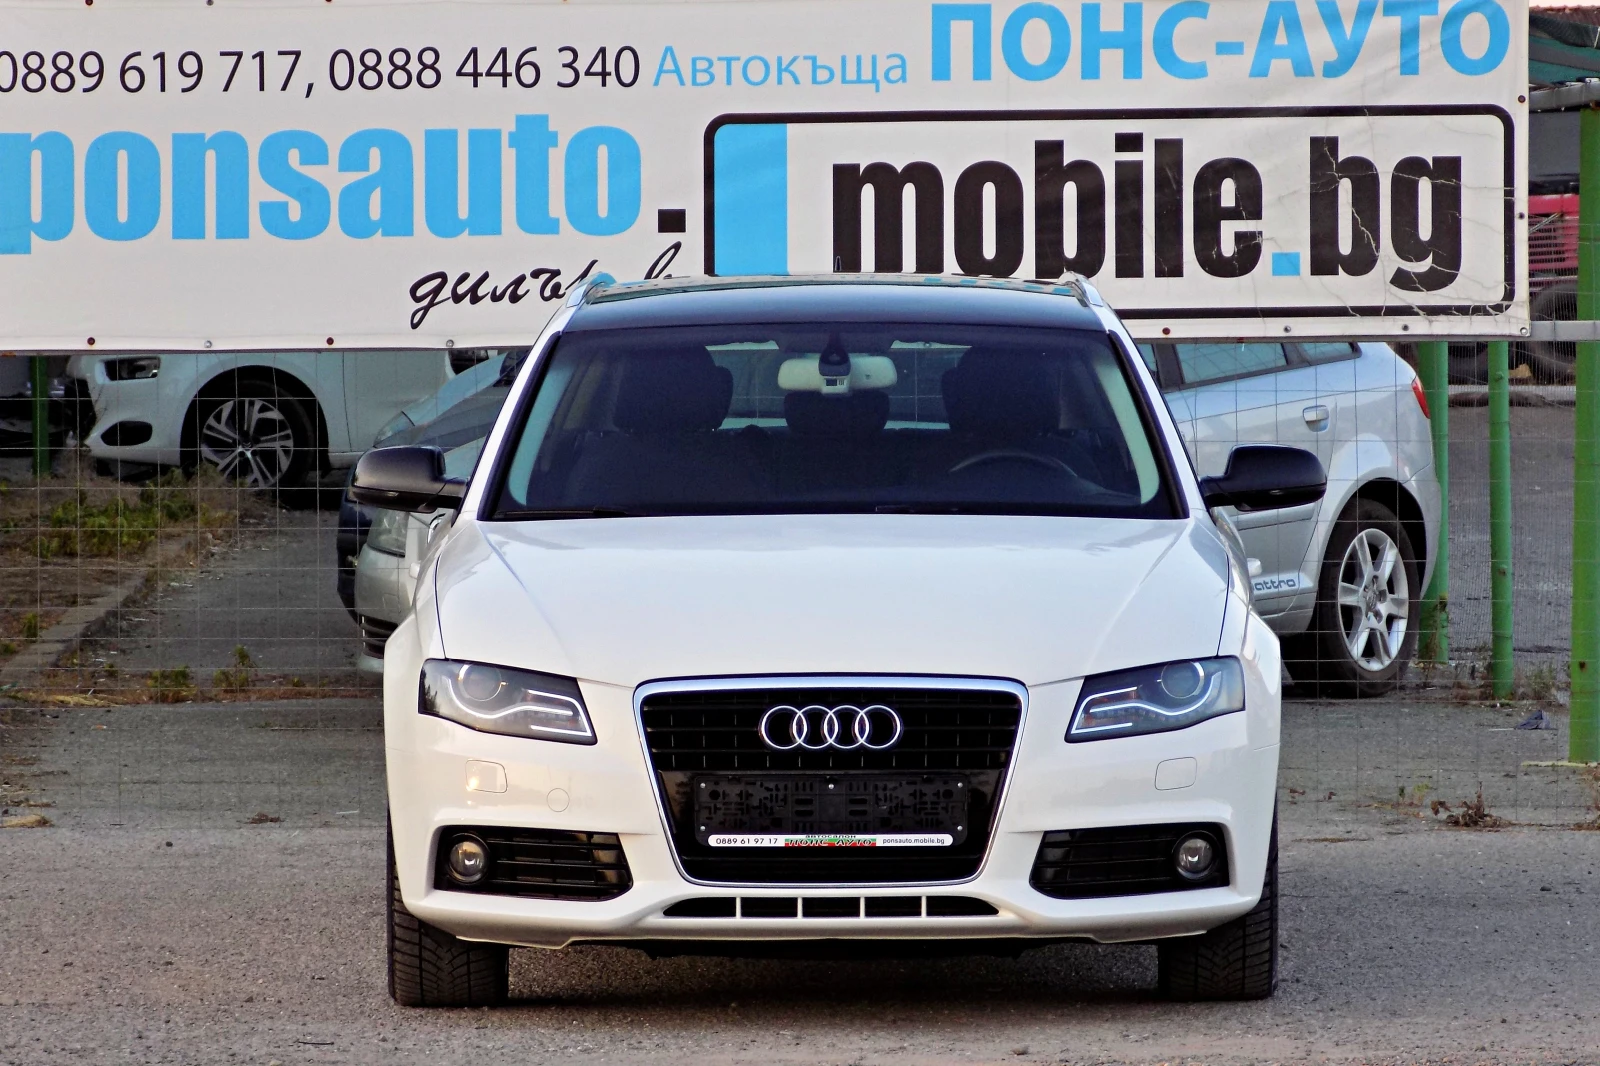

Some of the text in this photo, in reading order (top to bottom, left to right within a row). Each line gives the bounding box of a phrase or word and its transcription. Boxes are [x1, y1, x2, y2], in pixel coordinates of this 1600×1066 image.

[0, 0, 1511, 99] 0889 619 717, 0888 446 340 Автокъща ПОНС-АУТО
[833, 132, 1463, 292] mobile.bg
